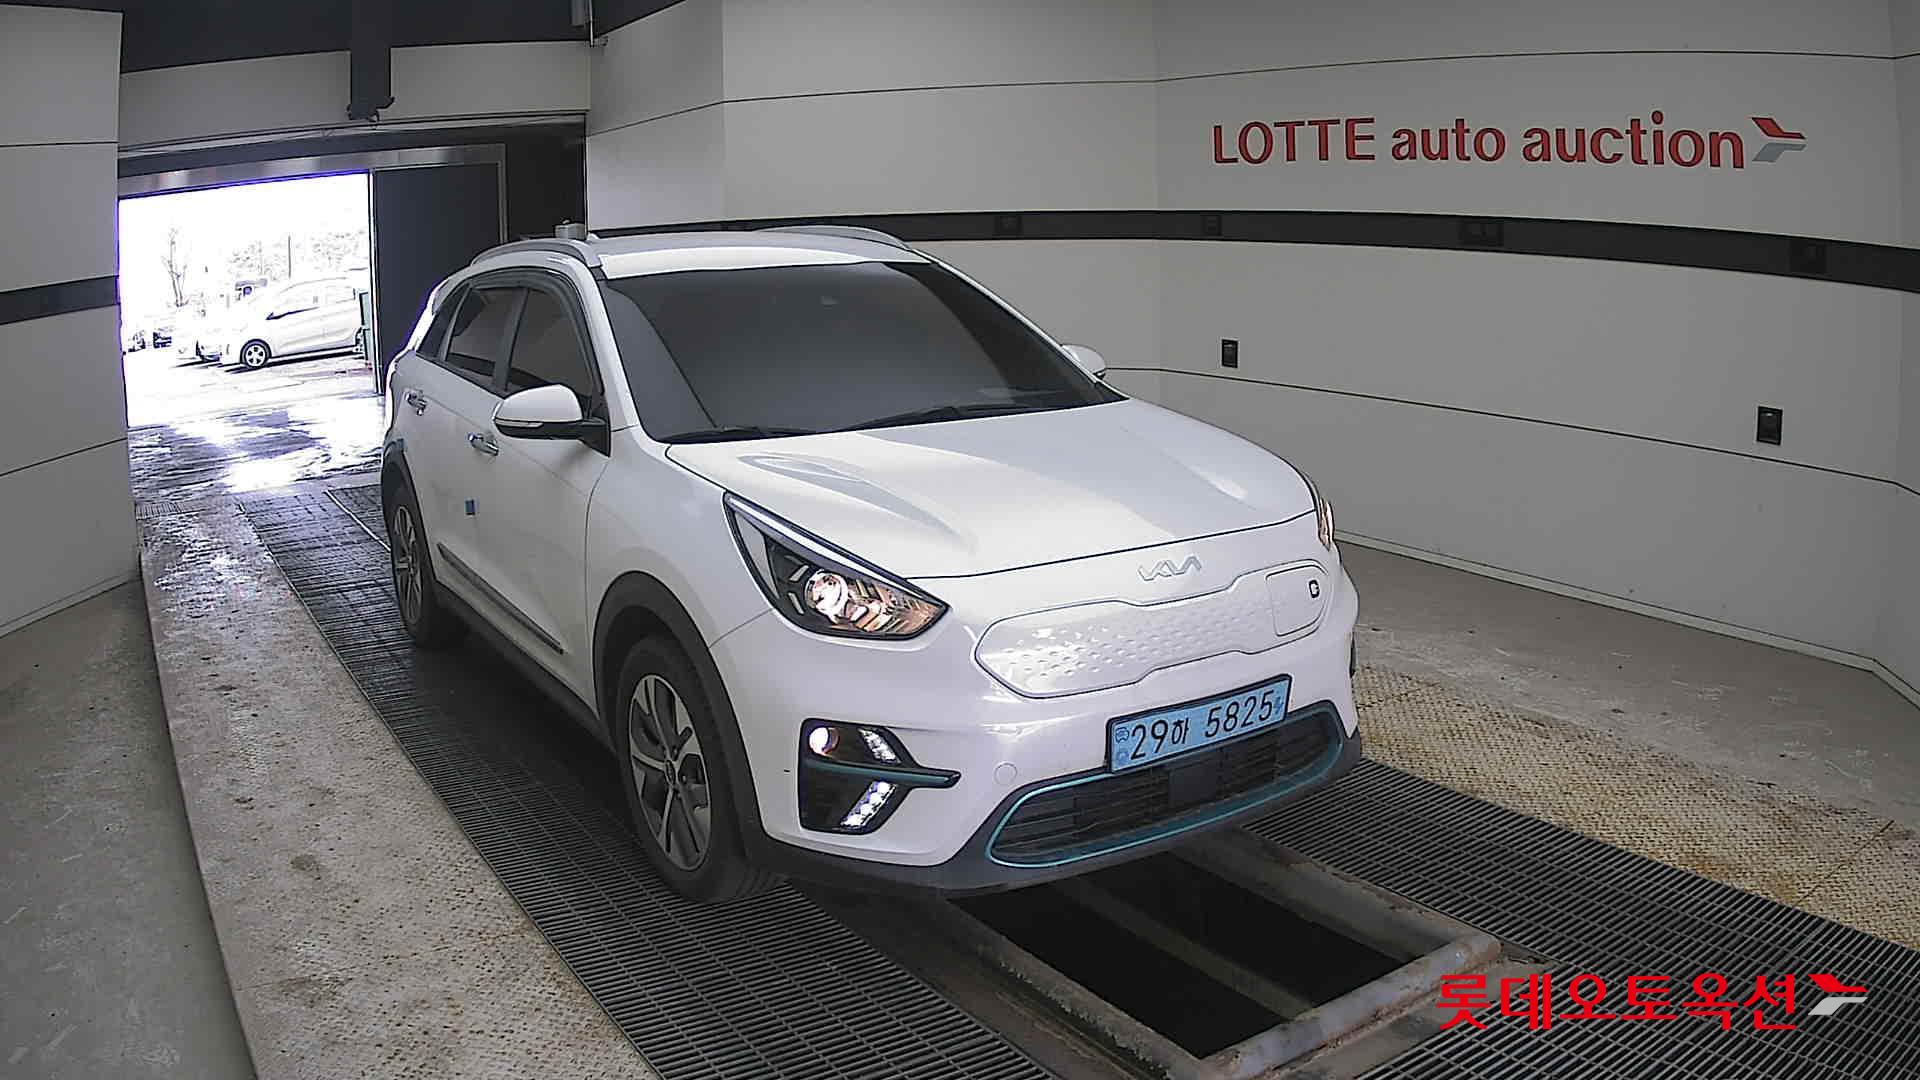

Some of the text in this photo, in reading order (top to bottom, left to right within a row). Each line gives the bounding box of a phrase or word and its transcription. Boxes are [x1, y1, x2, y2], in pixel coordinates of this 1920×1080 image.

[1212, 110, 1745, 169] LOTTE auto auction
[1130, 689, 1275, 761] 29하 5825
